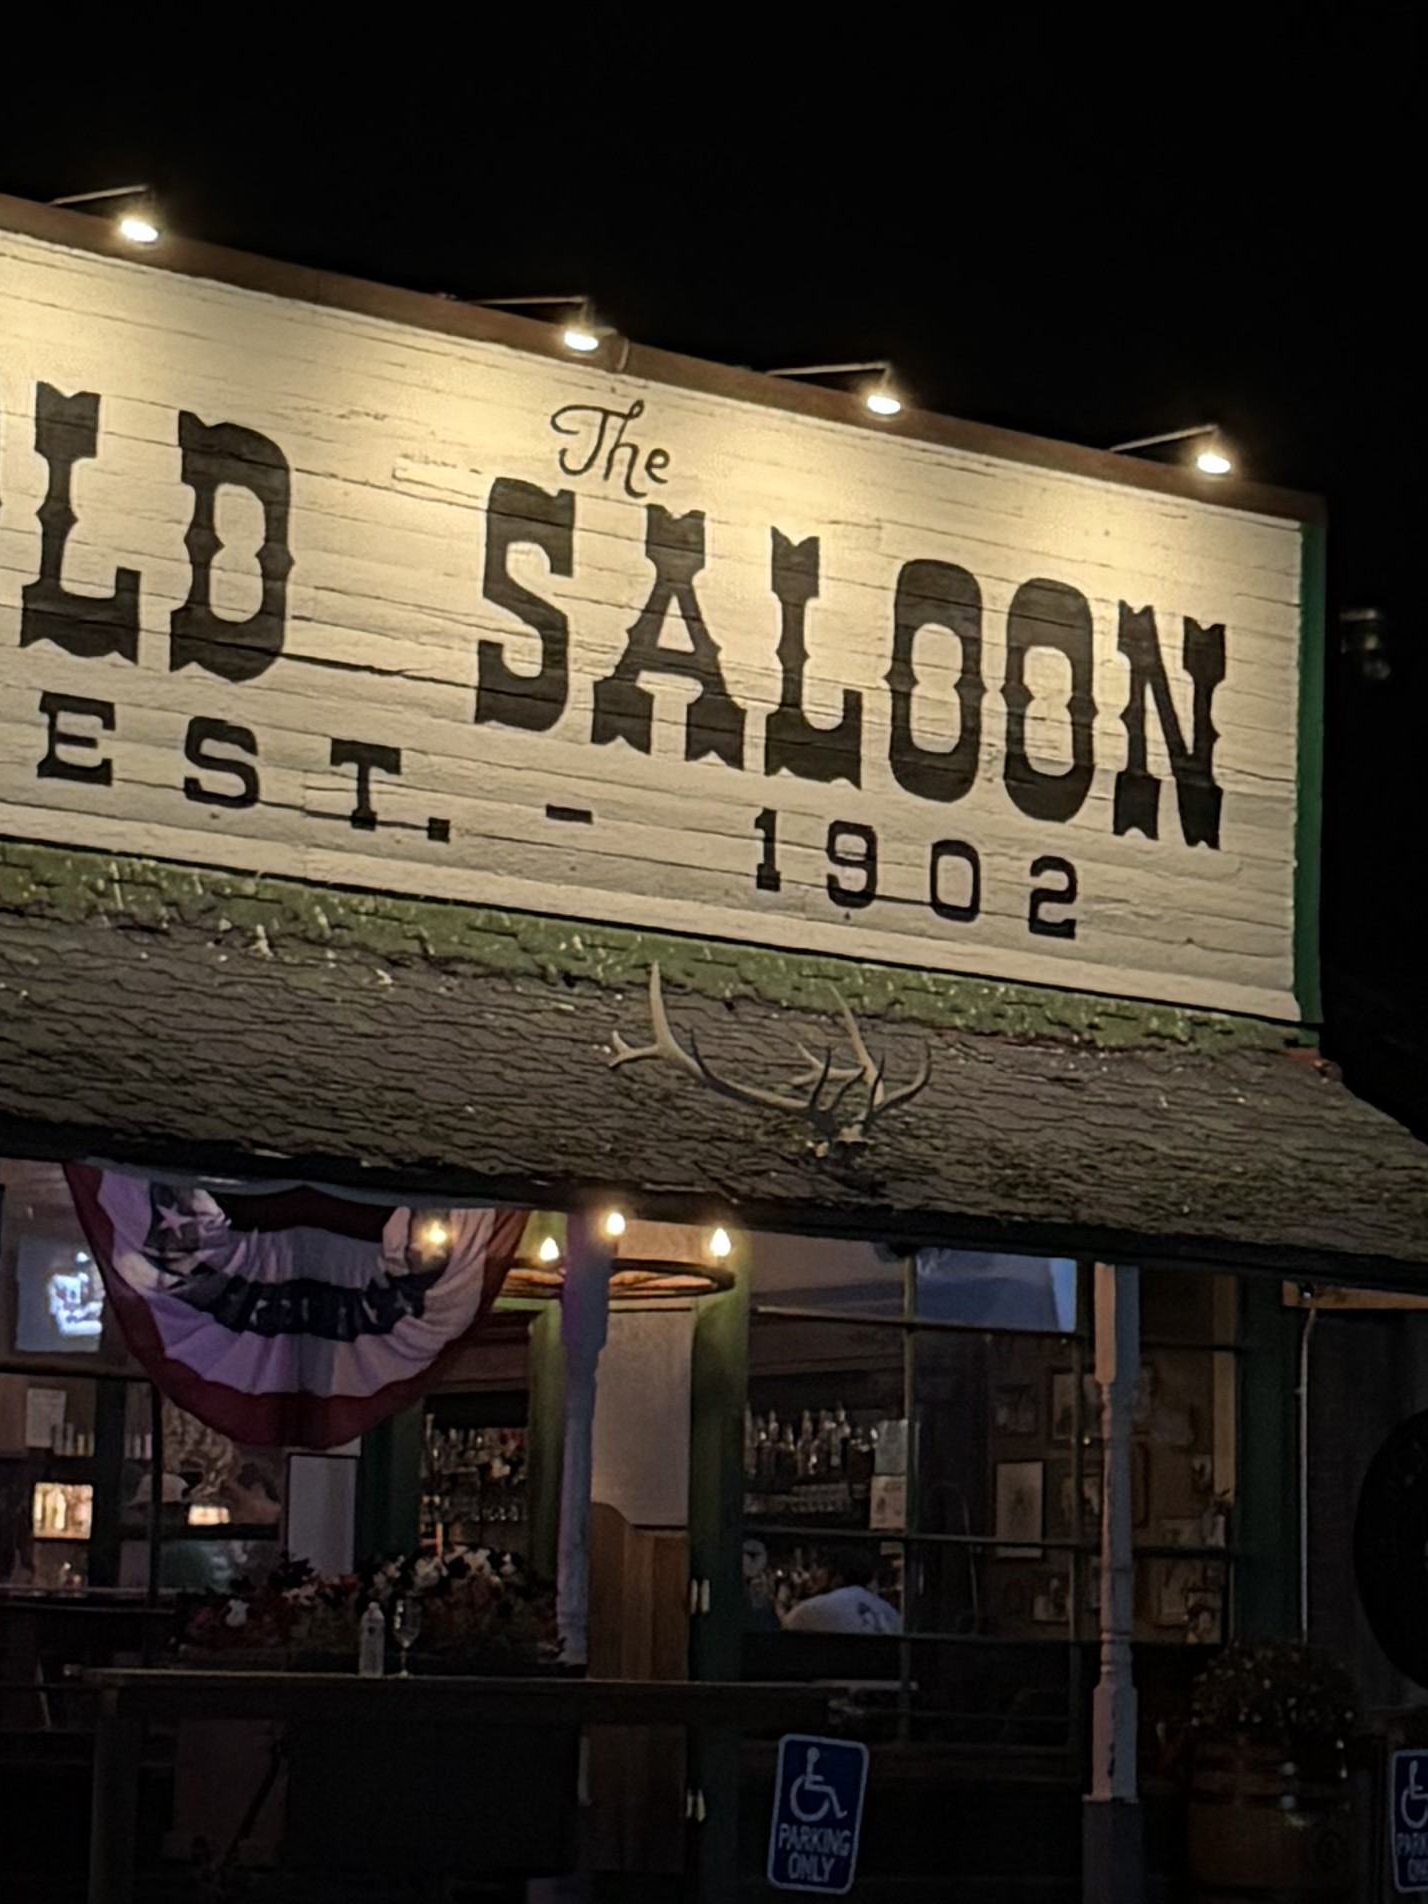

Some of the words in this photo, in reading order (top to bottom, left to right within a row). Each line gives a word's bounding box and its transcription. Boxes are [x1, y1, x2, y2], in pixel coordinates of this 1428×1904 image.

[551, 400, 671, 498] The
[475, 477, 1226, 849] SALOON
[37, 691, 450, 841] EST.
[754, 808, 1077, 938] 1902
[778, 1822, 852, 1857] PARKING
[787, 1850, 836, 1884] ONLY
